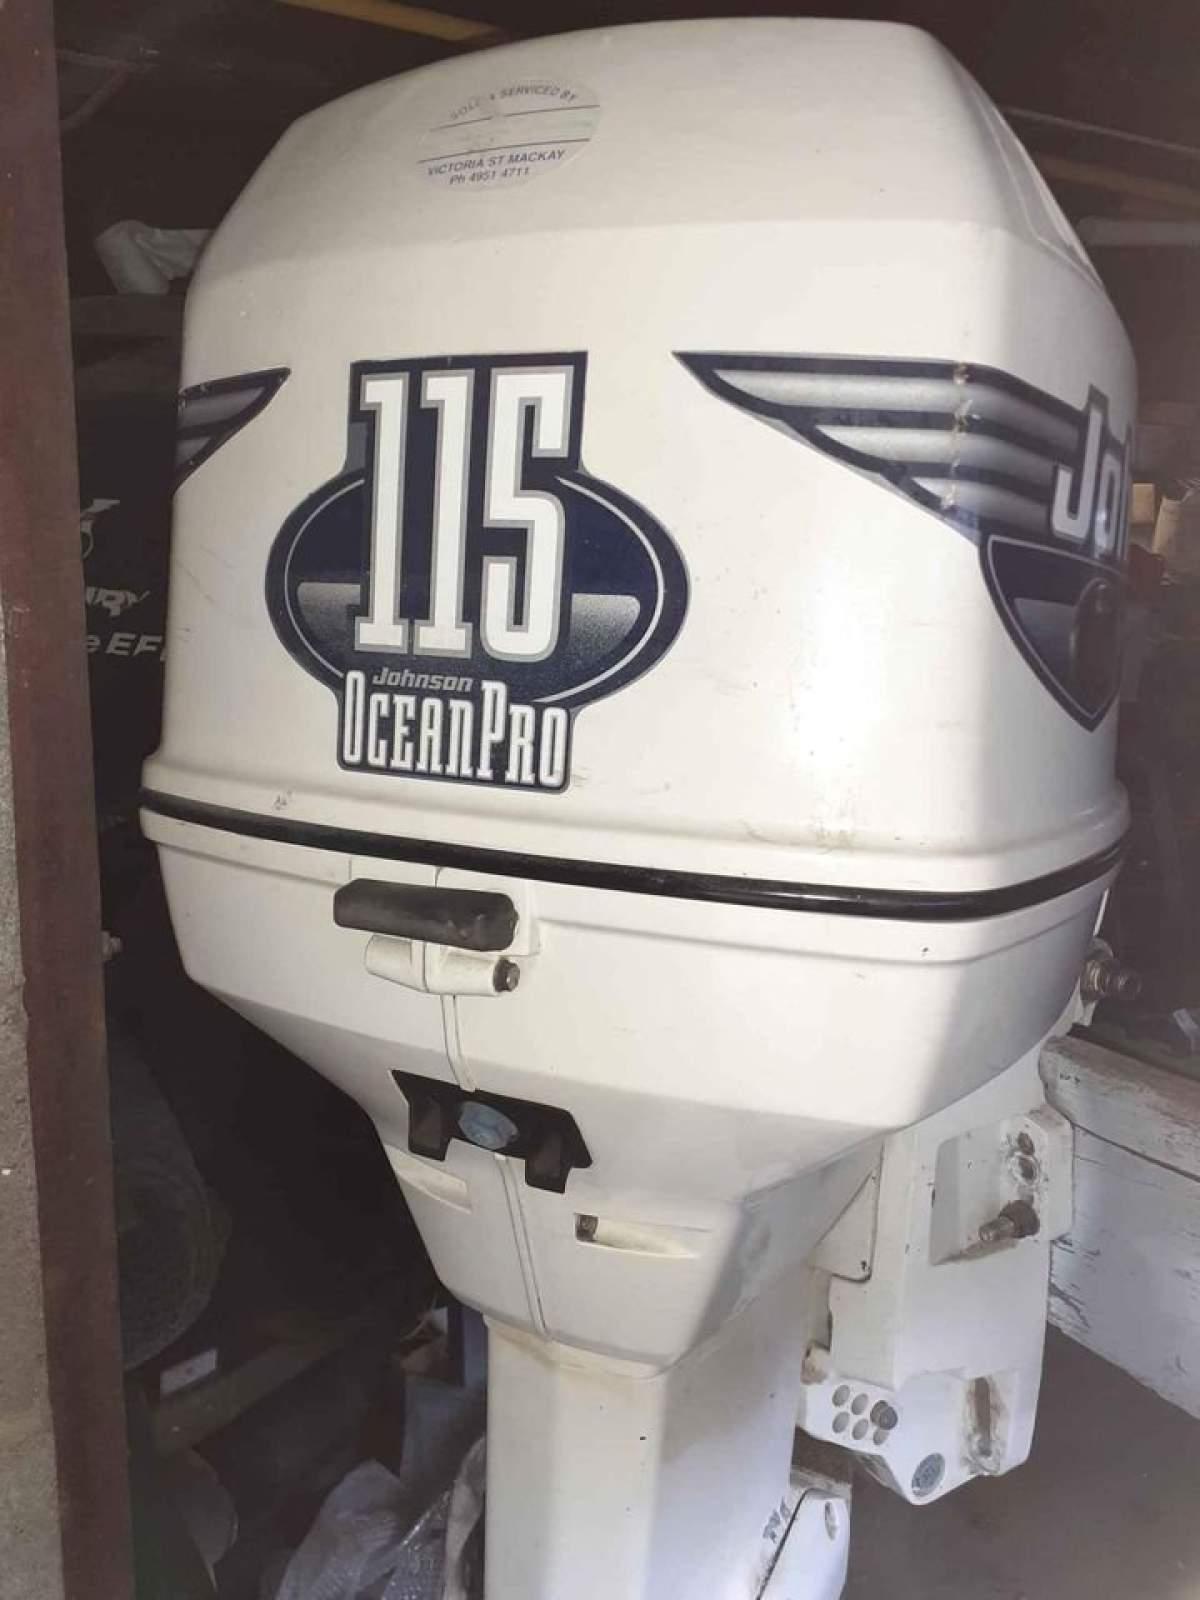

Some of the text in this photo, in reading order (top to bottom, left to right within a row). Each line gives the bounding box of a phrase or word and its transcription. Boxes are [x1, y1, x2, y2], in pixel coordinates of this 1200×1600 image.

[500, 84, 561, 99] SERVICED
[427, 149, 566, 176] VICTORIA ST MACKAY
[449, 166, 530, 186] Ph 4951 4711
[355, 364, 575, 662] 115
[372, 667, 474, 693] Johnson
